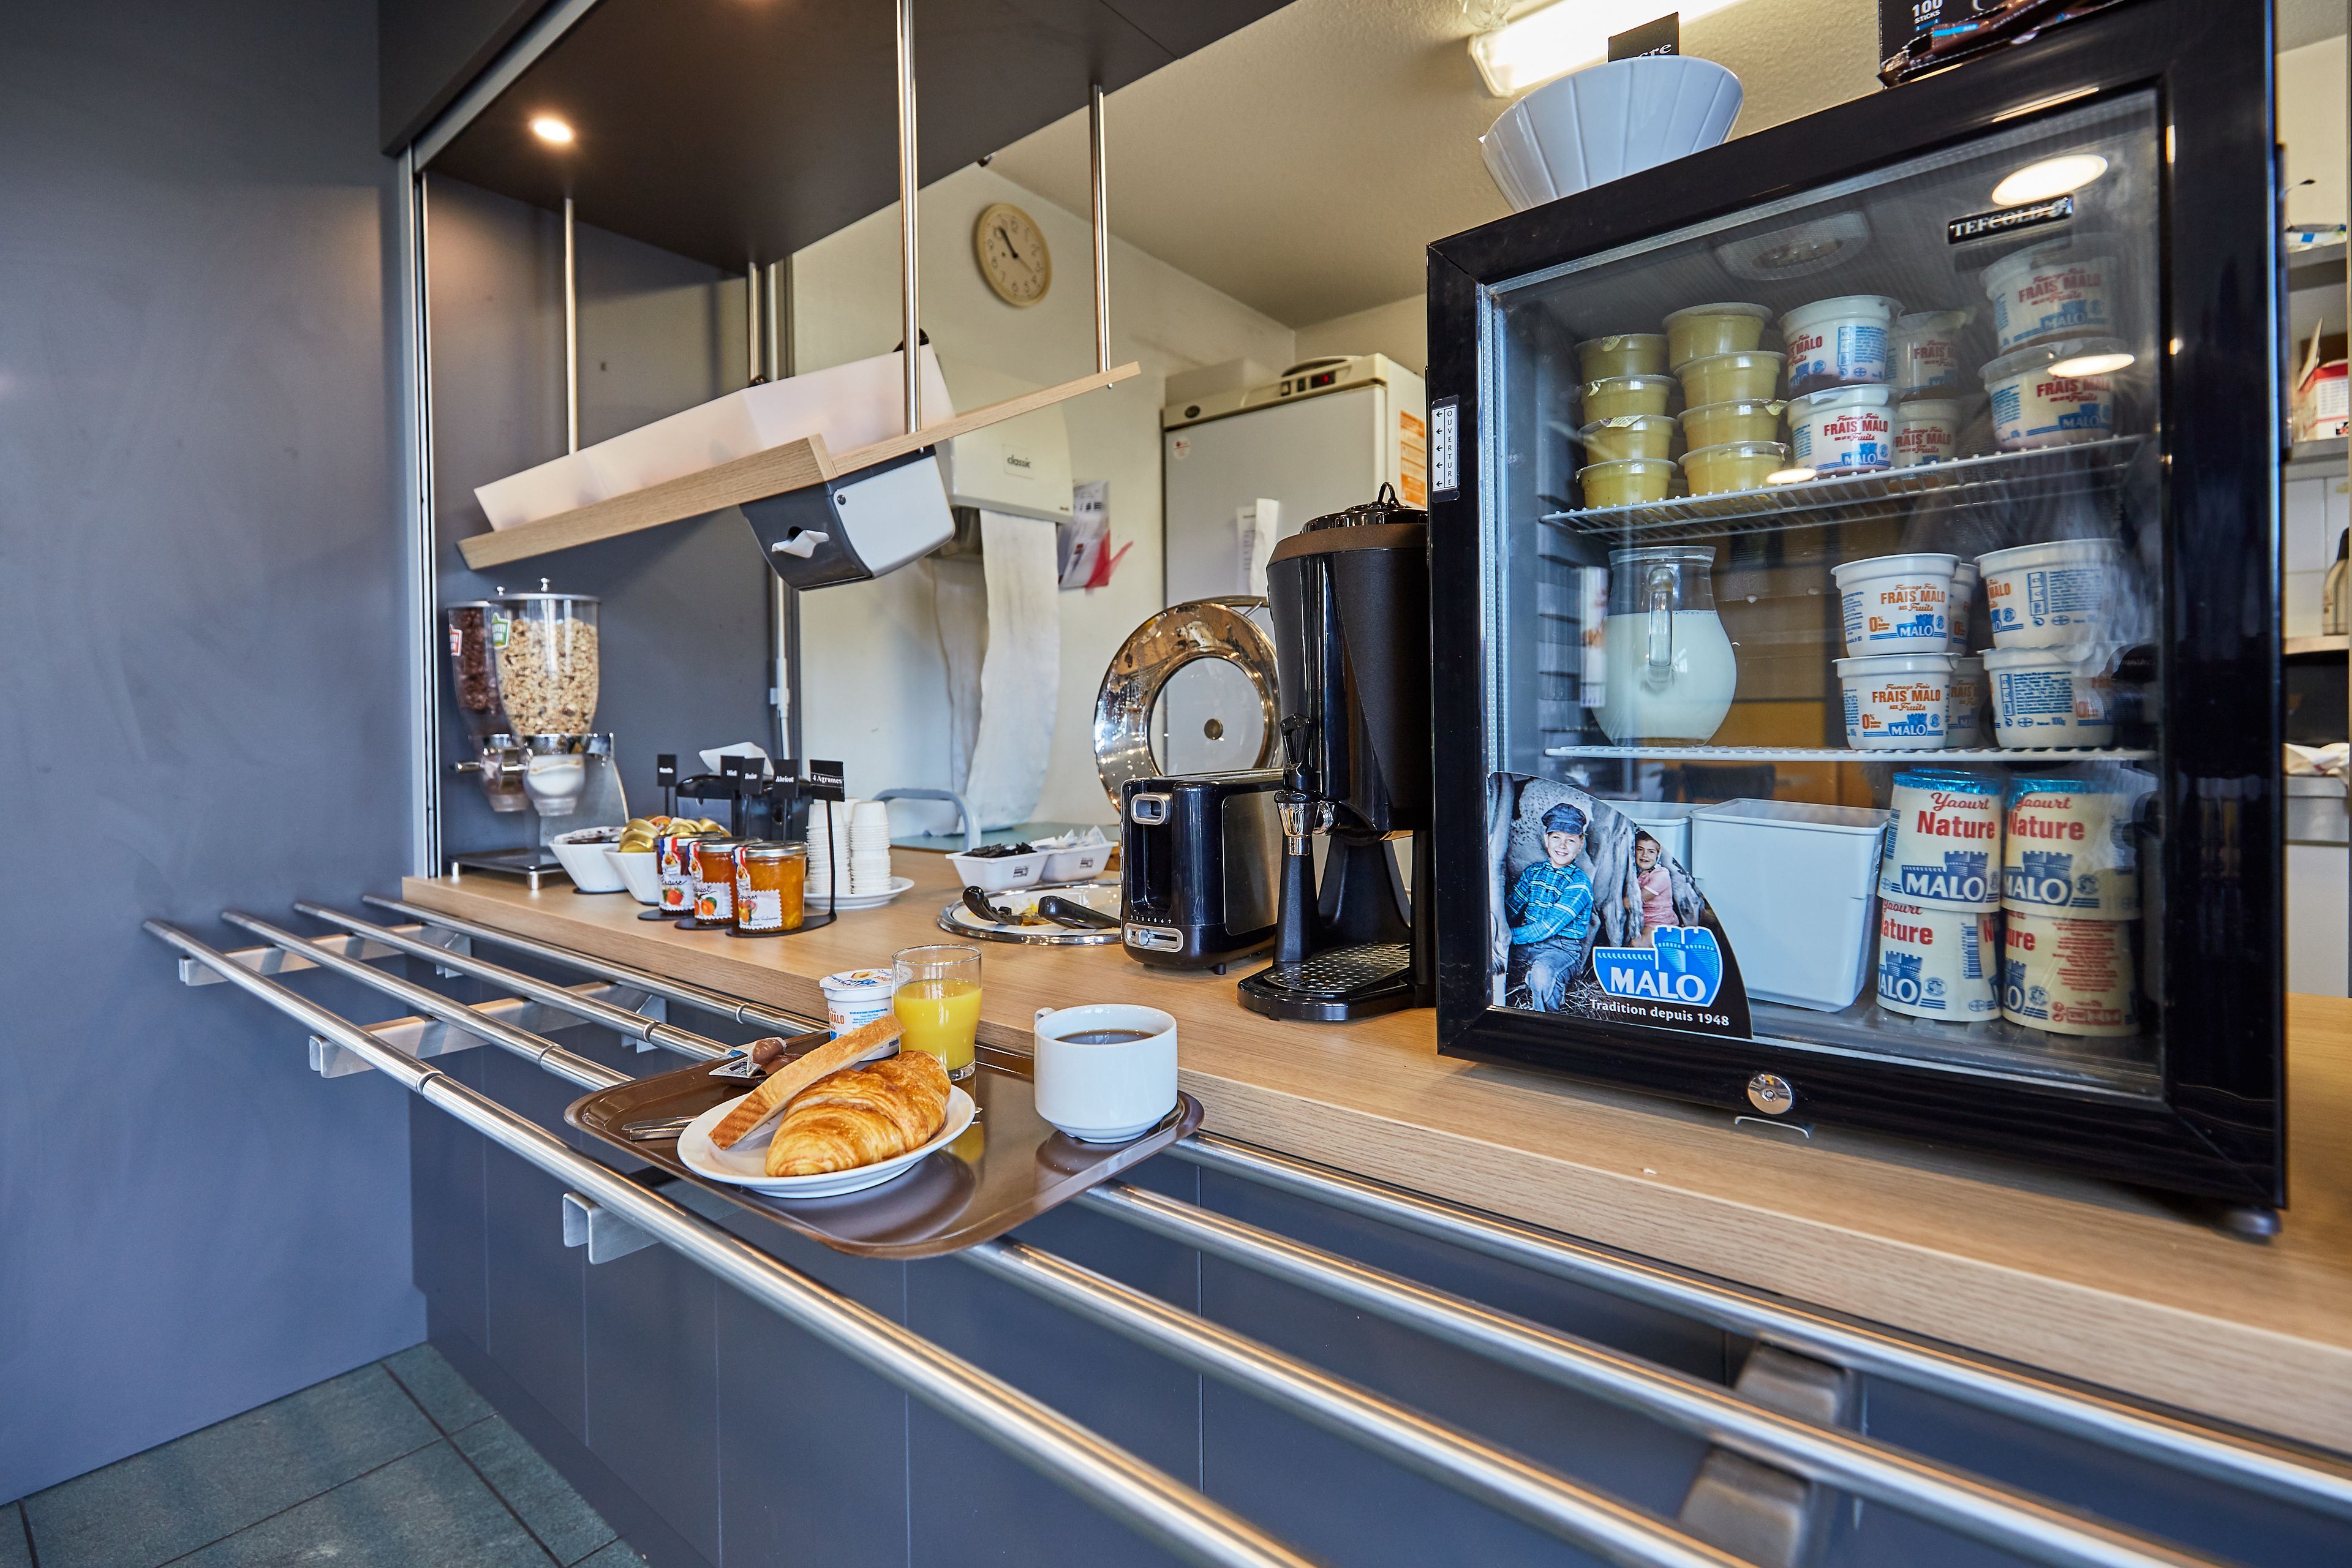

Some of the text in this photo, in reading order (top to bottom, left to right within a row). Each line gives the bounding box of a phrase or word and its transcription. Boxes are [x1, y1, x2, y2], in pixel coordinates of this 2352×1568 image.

[1912, 0, 1943, 17] 100
[1914, 9, 1940, 24] STICKS
[2018, 279, 2058, 303] FRAIS
[2045, 313, 2083, 328] MALO
[1796, 336, 1823, 355] MALO
[2037, 378, 2078, 398] FRAIS
[1824, 420, 1888, 436] FRAIS MALO
[2063, 416, 2100, 428] MALO
[1926, 433, 1951, 445] MALO
[1007, 454, 1031, 468] classic
[1844, 453, 1878, 465] MALO
[1880, 590, 1945, 605] FRAIS MALO
[1900, 625, 1933, 636] MALO
[1872, 689, 1940, 703] FRAIS MALO
[1899, 703, 1926, 711] Fruits
[1891, 725, 1926, 736] MALO
[817, 775, 843, 785] Agrumes
[1931, 792, 1990, 811] Yaourt
[1917, 811, 1996, 840] Nature
[2008, 812, 2086, 841] Nature
[1905, 873, 1985, 902] MALO
[1611, 967, 1706, 1002] MALO
[1879, 973, 1918, 1003] ALO
[829, 1011, 845, 1024] MALO
[1591, 999, 1730, 1027] Tradition depuis 1948
